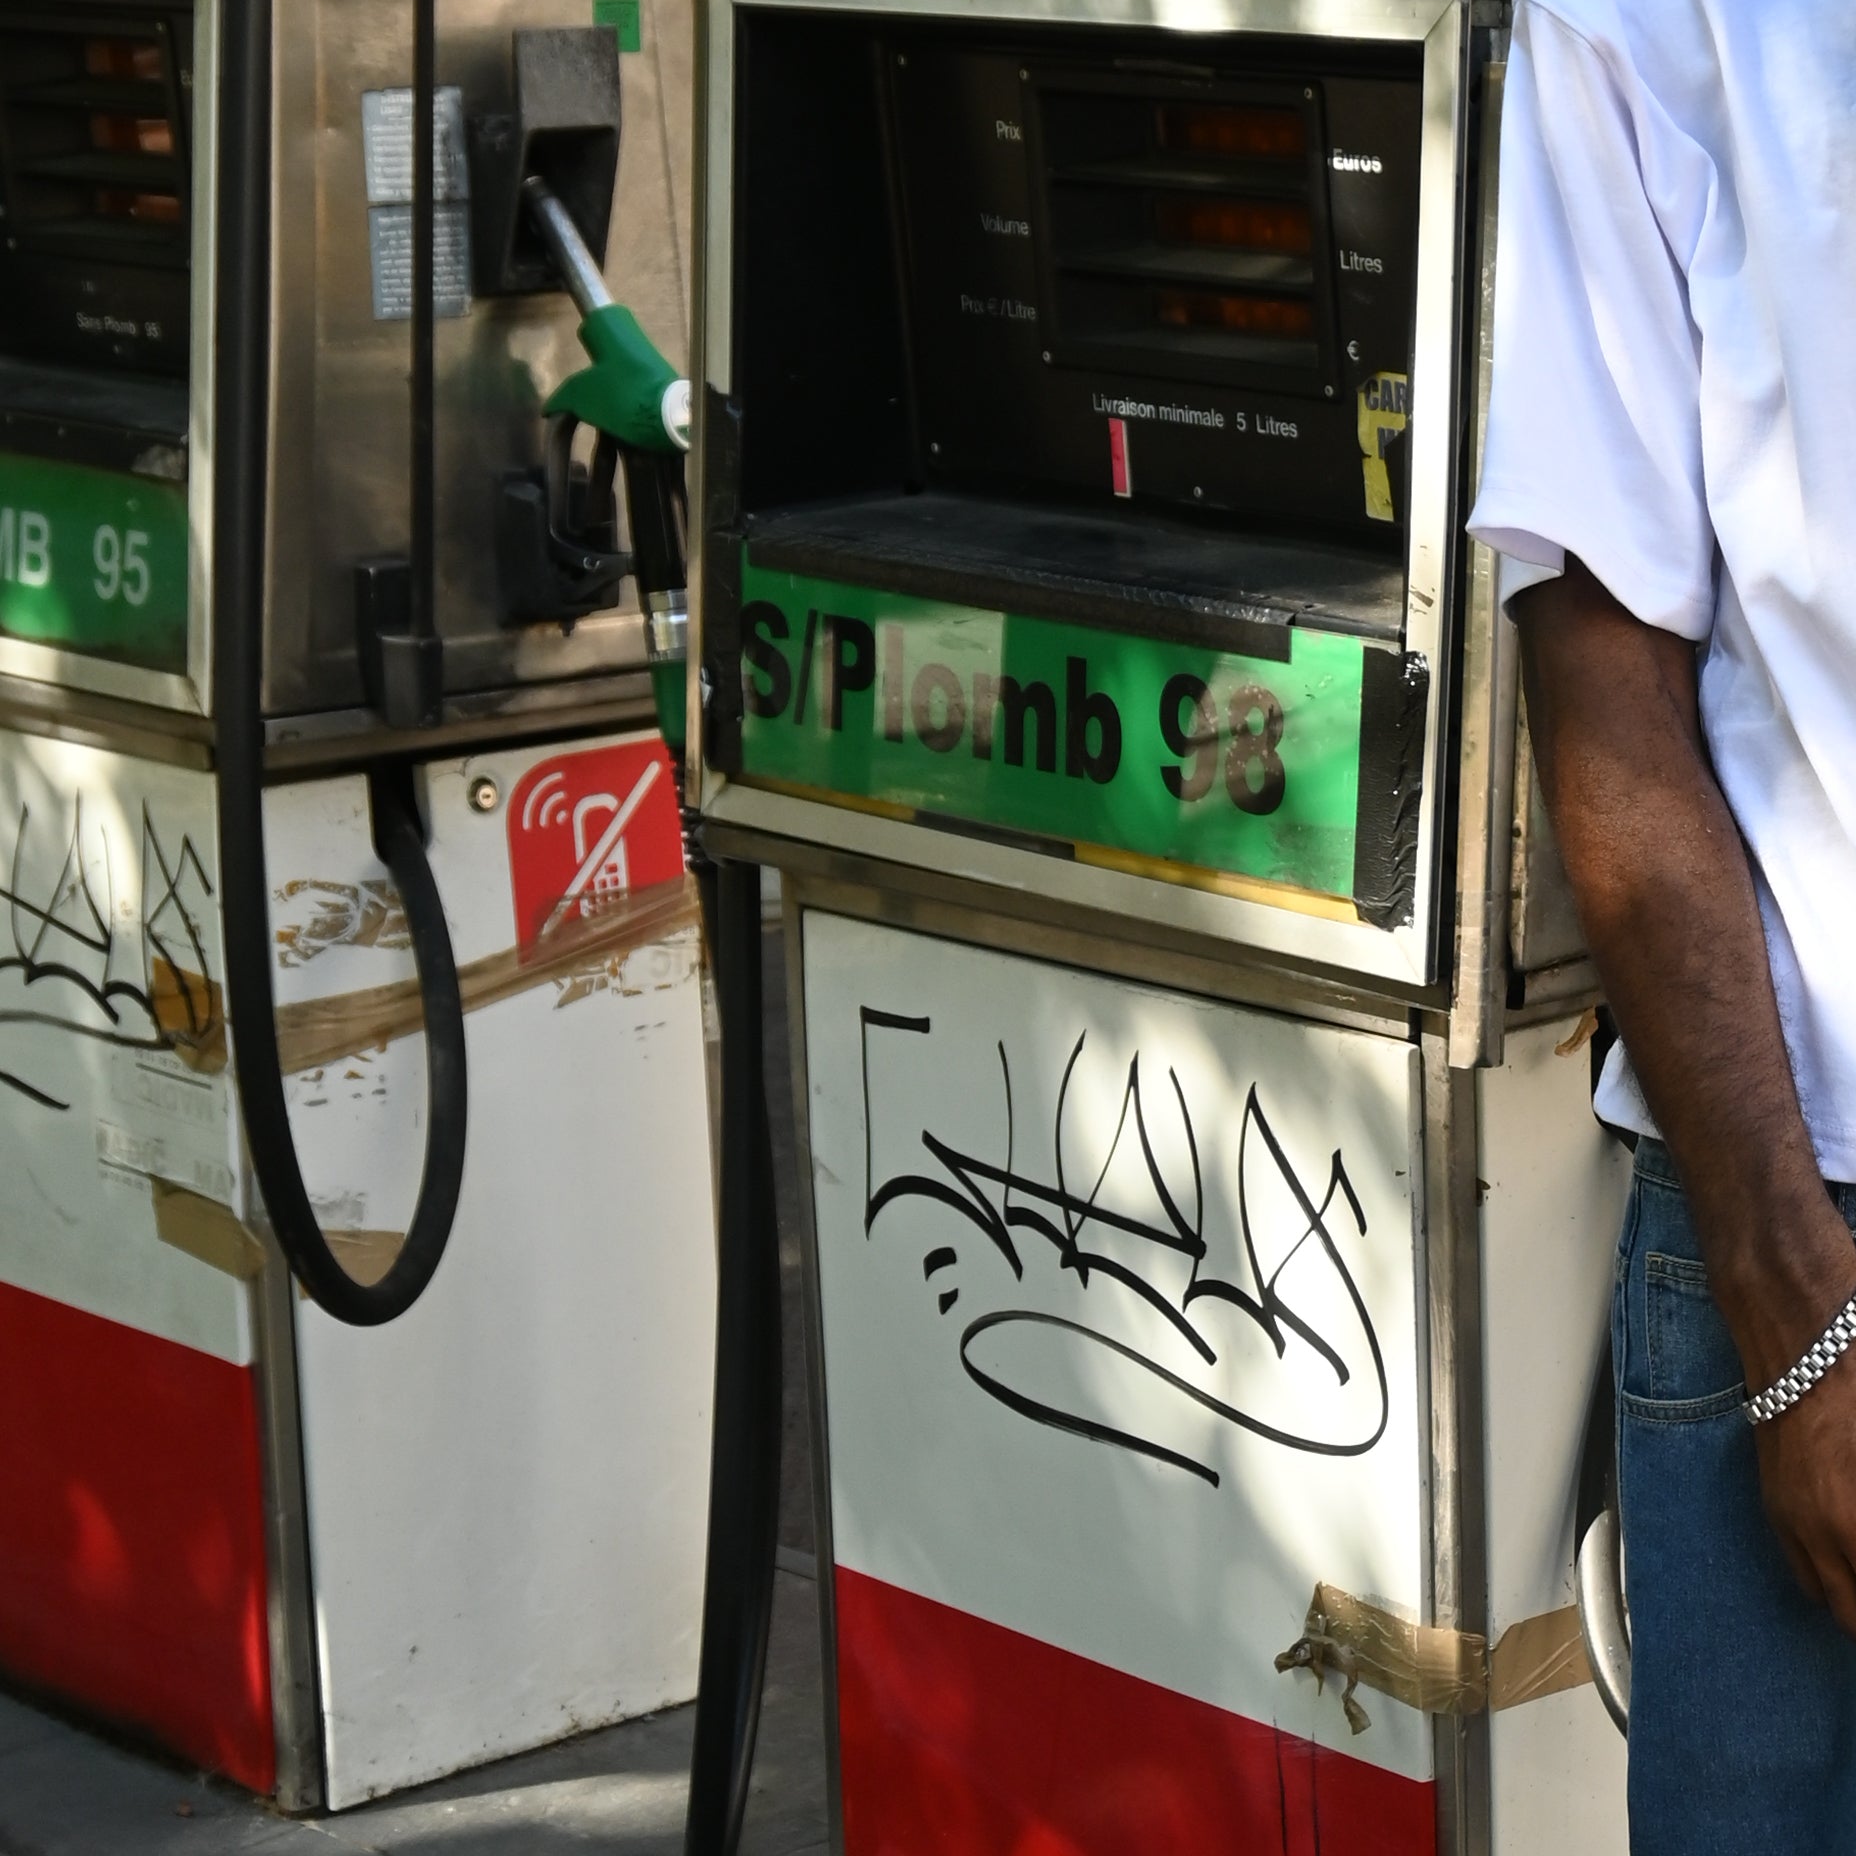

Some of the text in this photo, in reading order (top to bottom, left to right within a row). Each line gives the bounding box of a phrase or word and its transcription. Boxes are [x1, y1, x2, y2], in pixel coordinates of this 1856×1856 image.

[996, 120, 1021, 142] Prix
[1333, 148, 1383, 174] Euros
[980, 213, 1030, 237] Volume
[1339, 250, 1383, 275] Litres
[1092, 392, 1299, 439] Livraison minimale 5 Litres
[92, 523, 151, 607] 95
[740, 599, 1288, 816] S/Plomb 98
